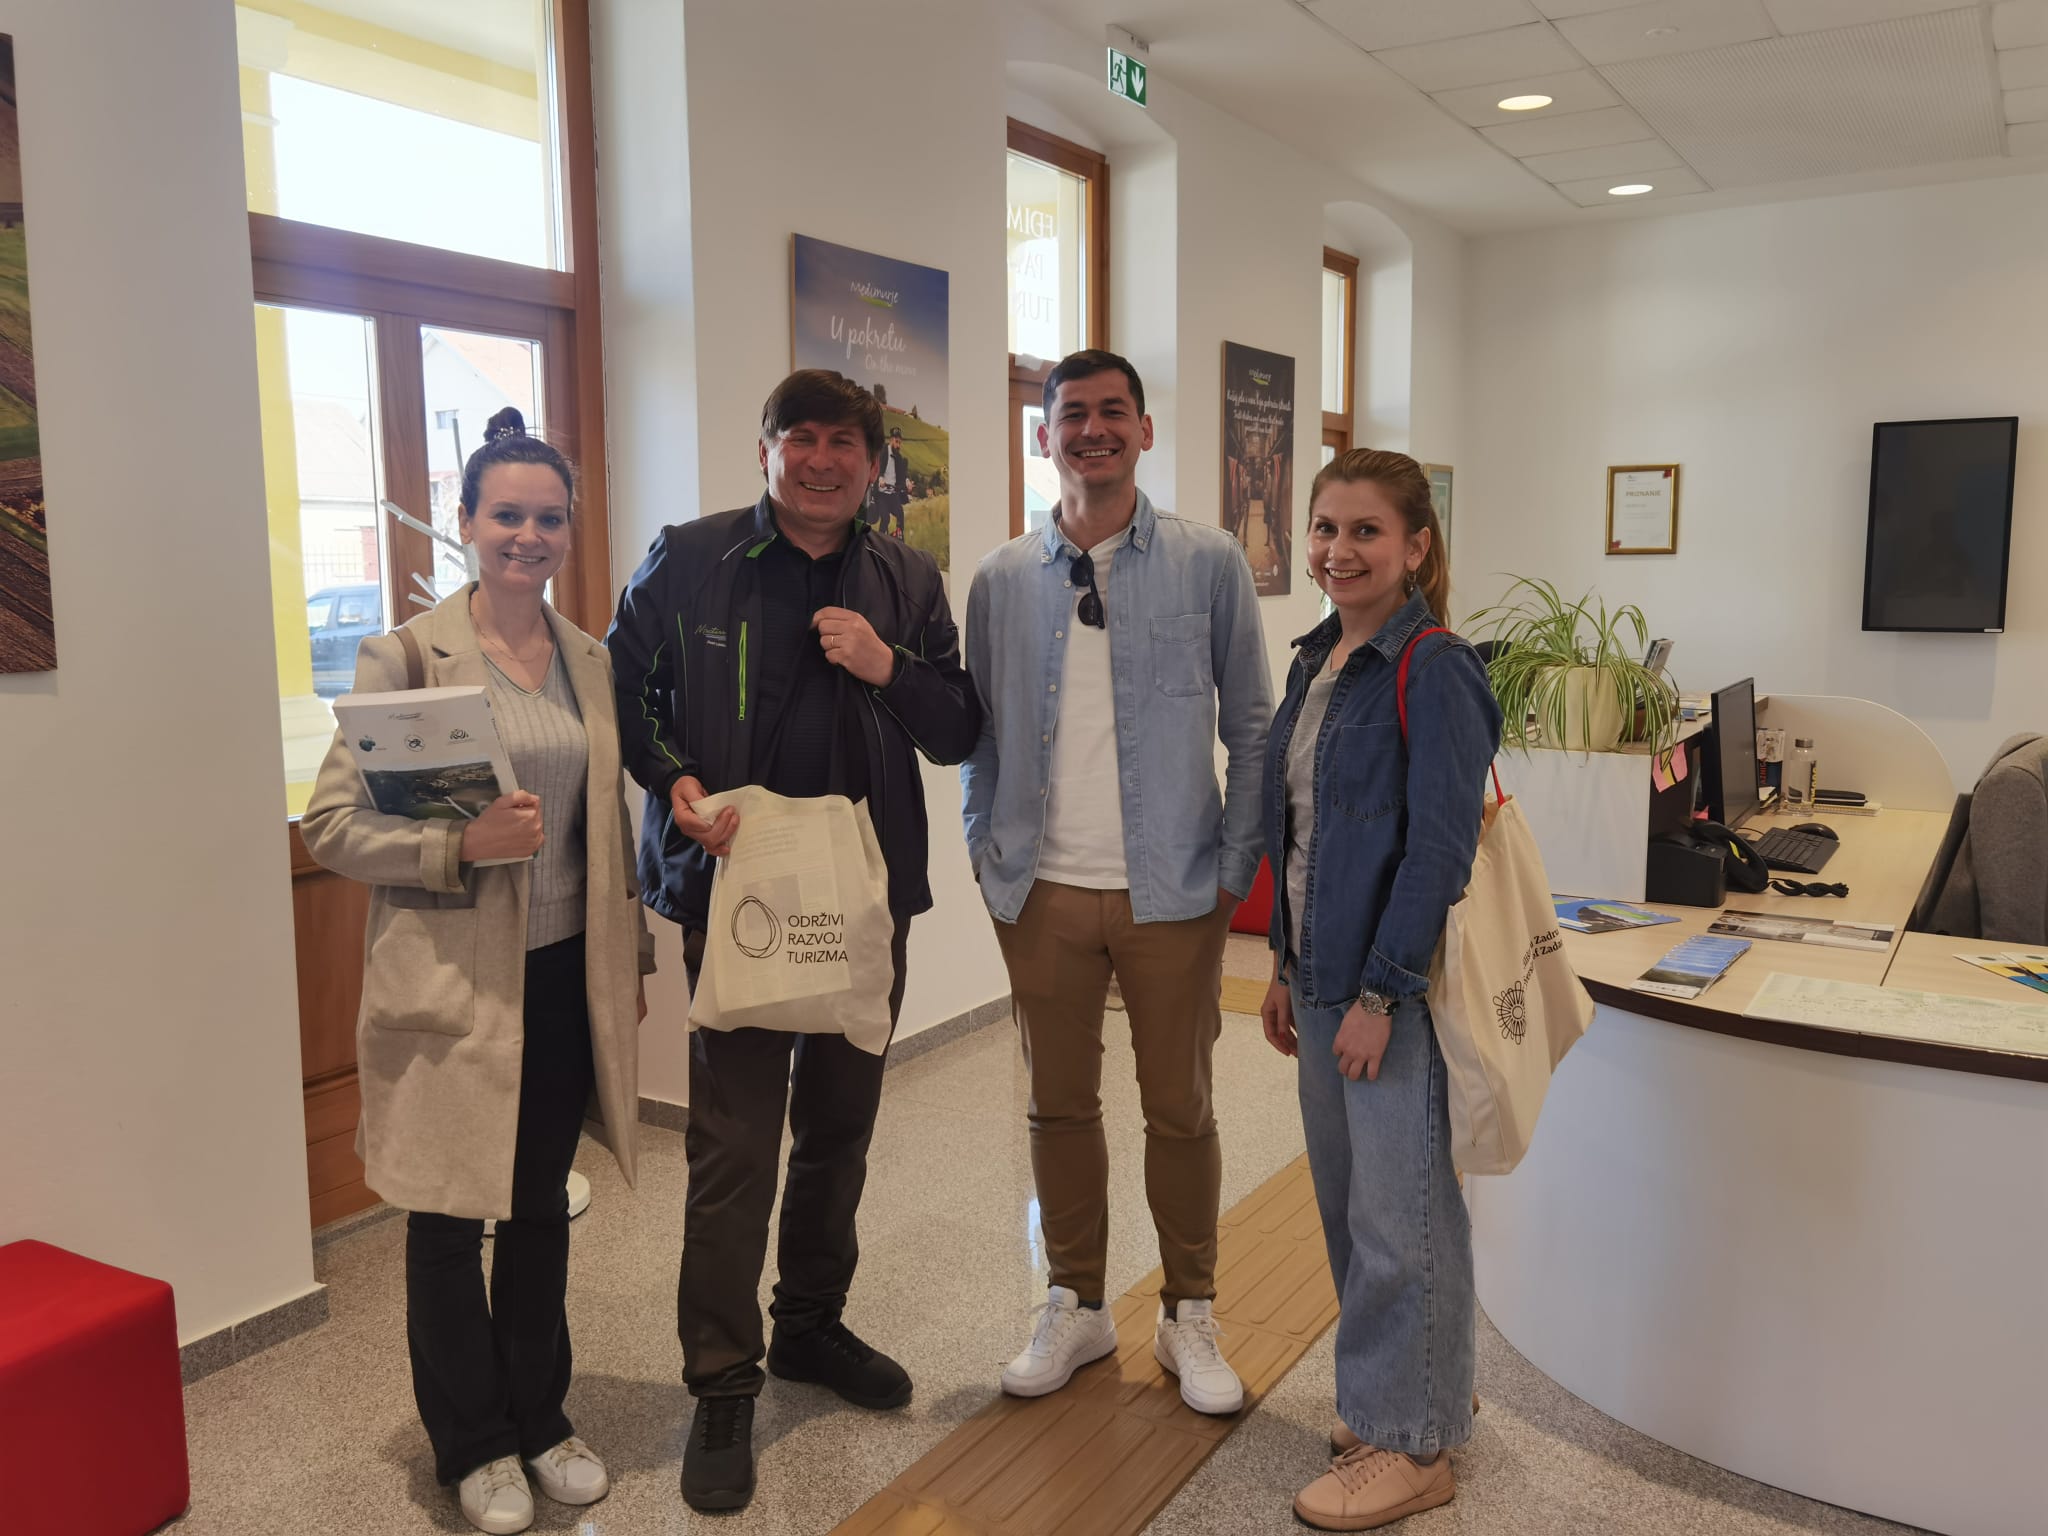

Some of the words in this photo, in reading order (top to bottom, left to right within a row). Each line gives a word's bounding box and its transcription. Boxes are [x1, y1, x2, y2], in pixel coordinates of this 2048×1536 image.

[831, 315, 844, 342] U
[787, 912, 844, 928] ODRŽIVI
[787, 932, 843, 946] RAZVOJ
[787, 950, 849, 964] TURIZMA
